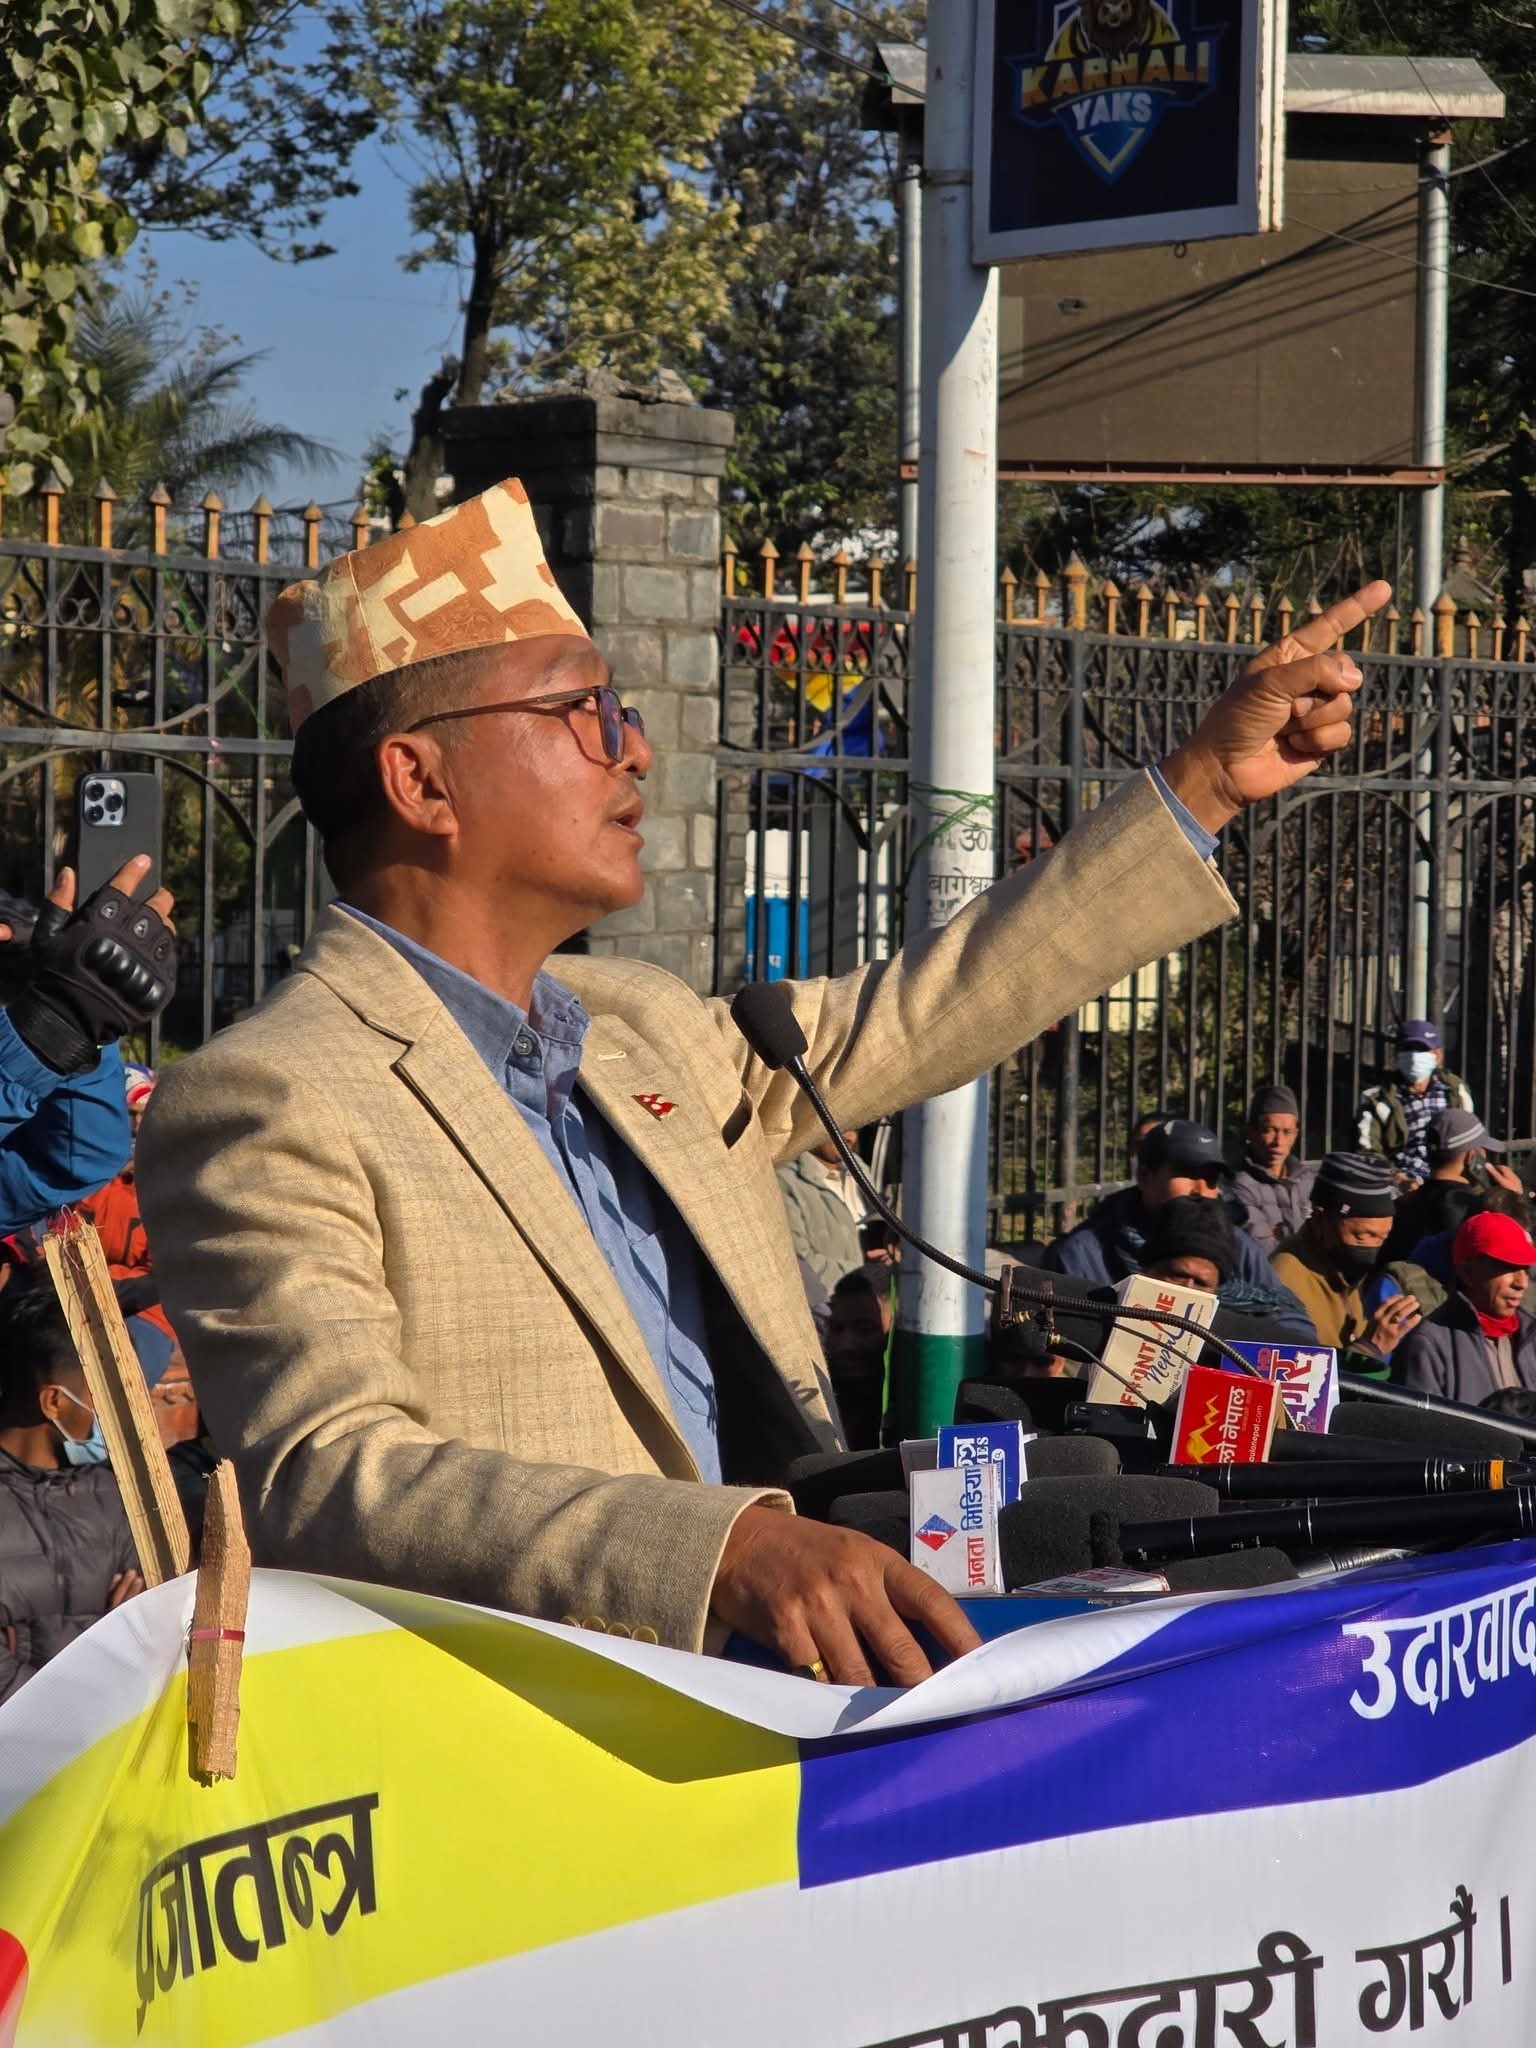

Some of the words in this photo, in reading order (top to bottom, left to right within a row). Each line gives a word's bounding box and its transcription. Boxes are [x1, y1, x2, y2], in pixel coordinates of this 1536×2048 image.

[1021, 41, 1210, 110] KARNALI
[1071, 92, 1152, 131] YAKS
[1219, 1385, 1246, 1440] नेपाल
[959, 1468, 984, 1532] मिडिया
[967, 1536, 986, 1588] जनता
